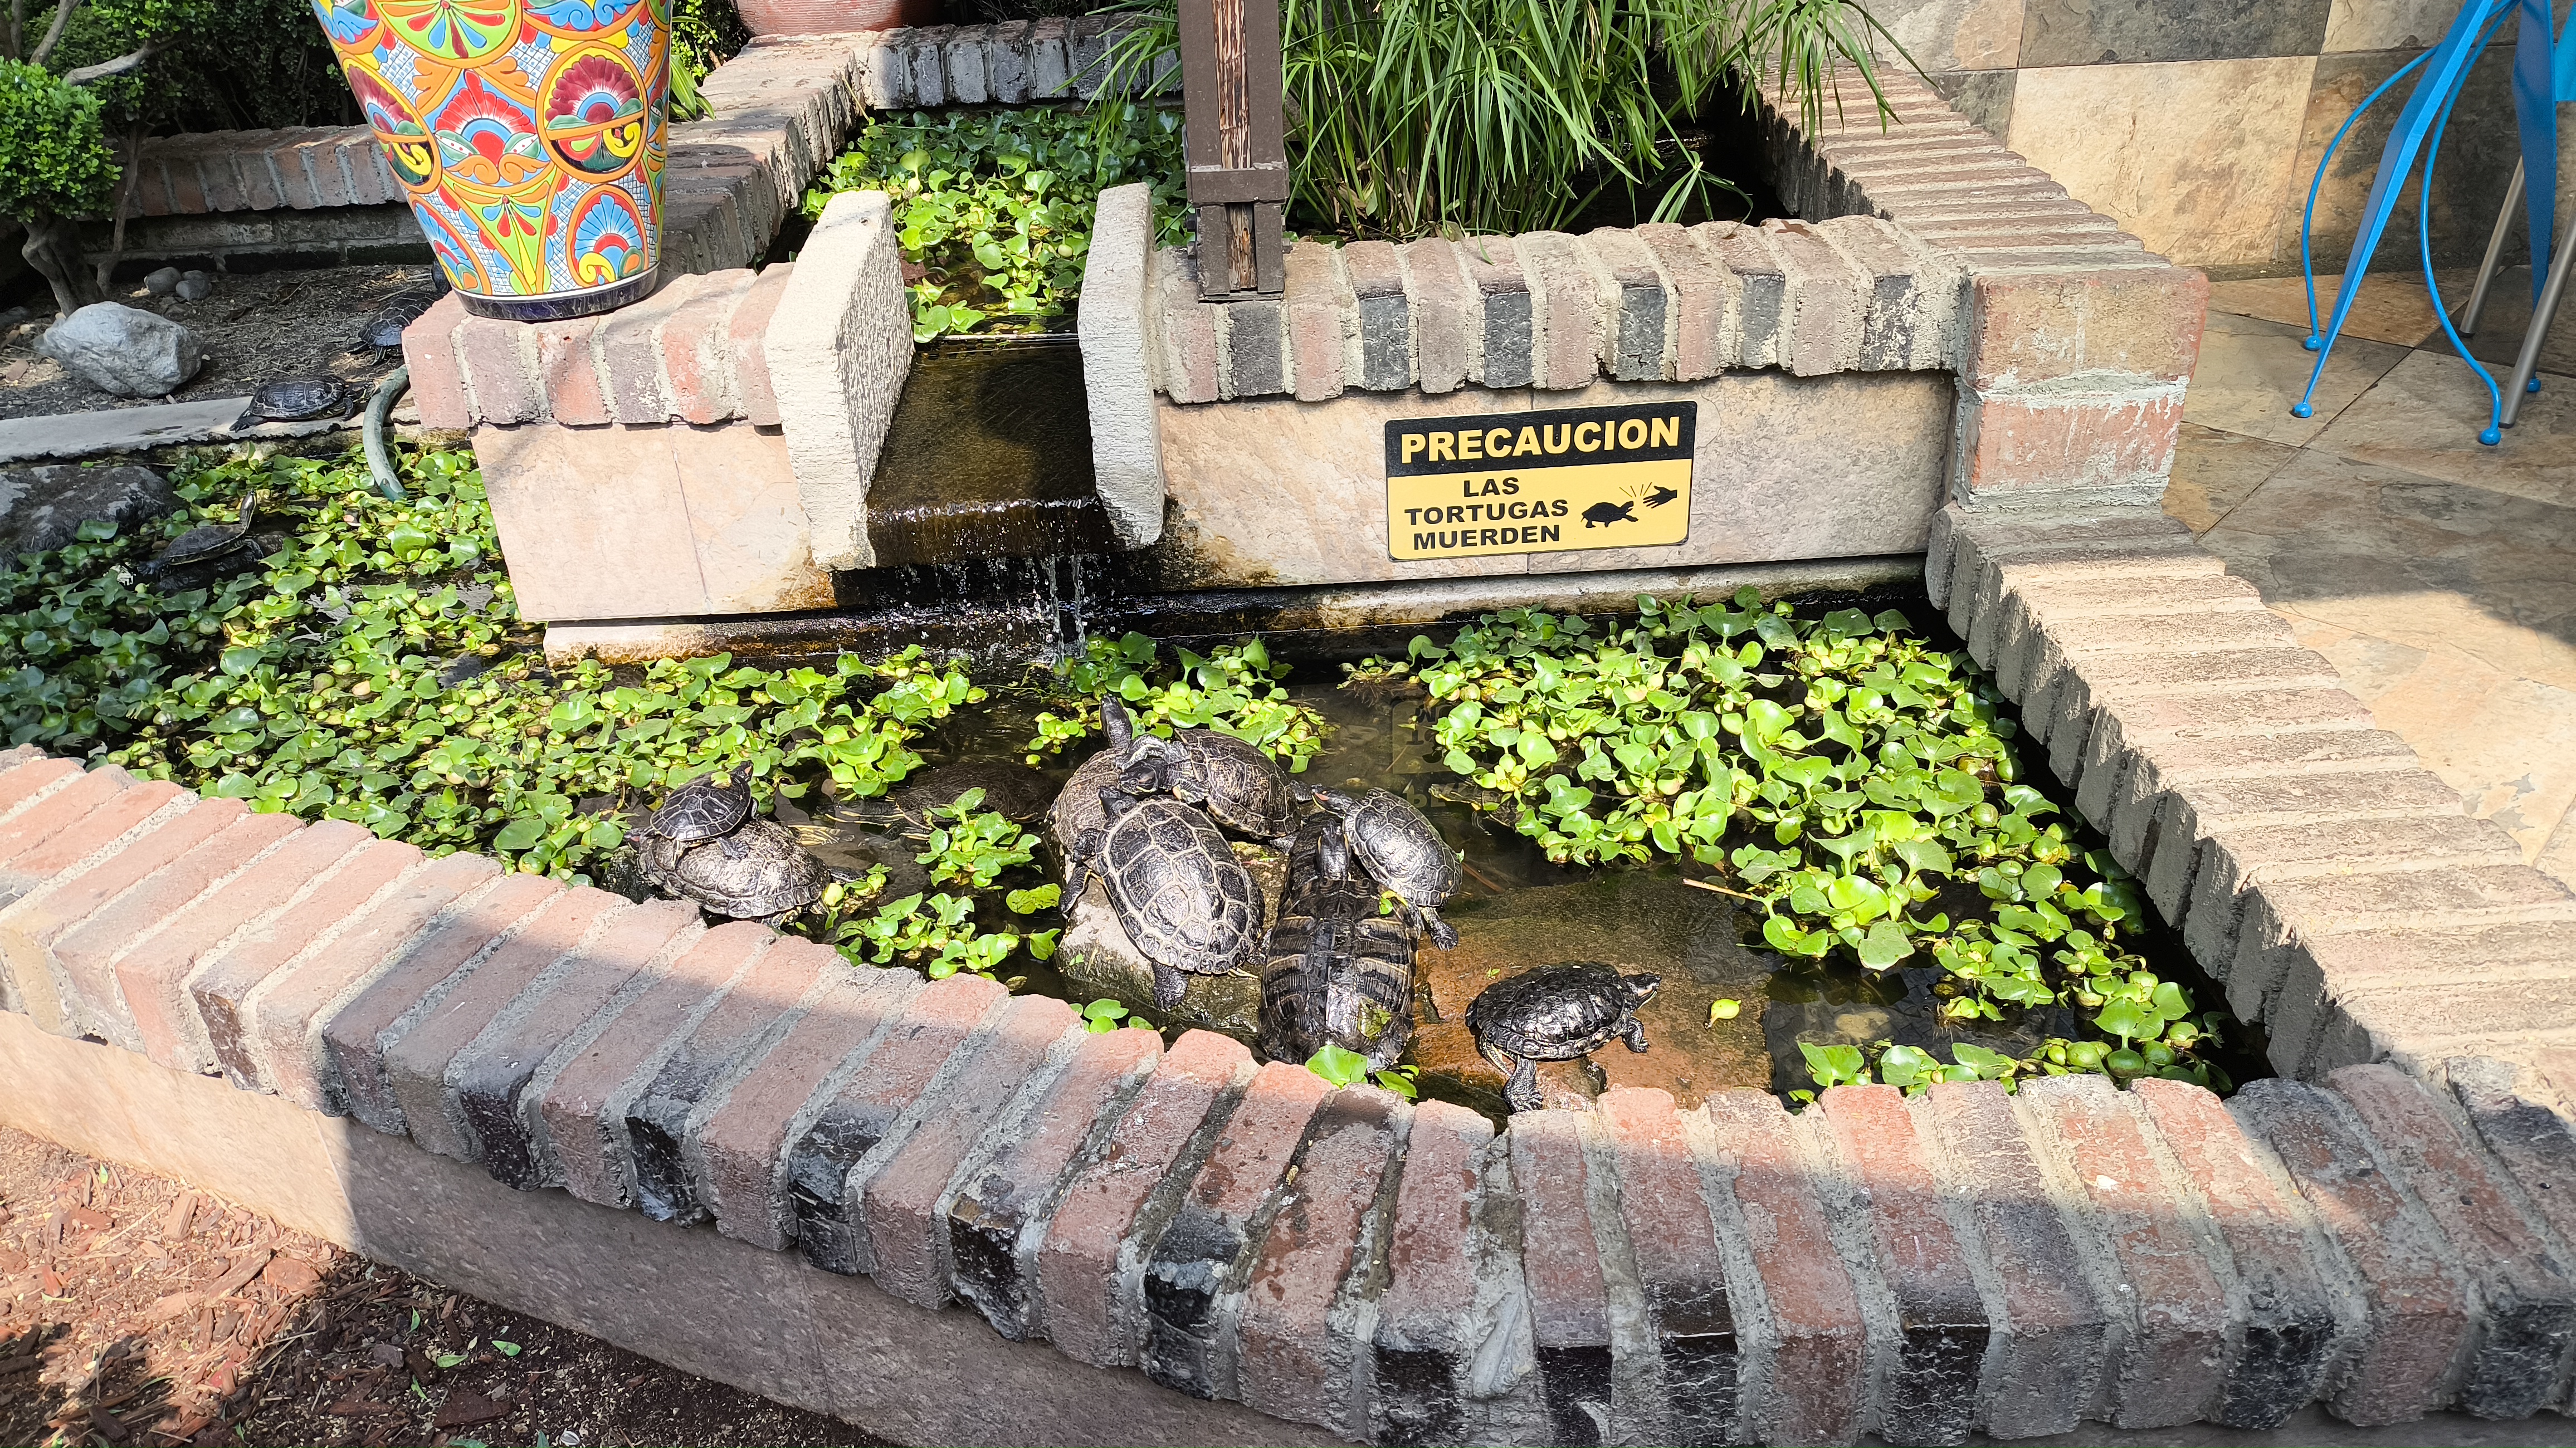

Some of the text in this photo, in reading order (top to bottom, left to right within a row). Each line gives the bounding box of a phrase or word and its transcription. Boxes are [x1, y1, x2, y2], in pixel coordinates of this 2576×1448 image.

[1401, 416, 1680, 463] PRECAUCION
[1463, 477, 1519, 497] LAS
[1404, 499, 1568, 526] TORTUGAS
[1413, 524, 1559, 550] MUERDEN
